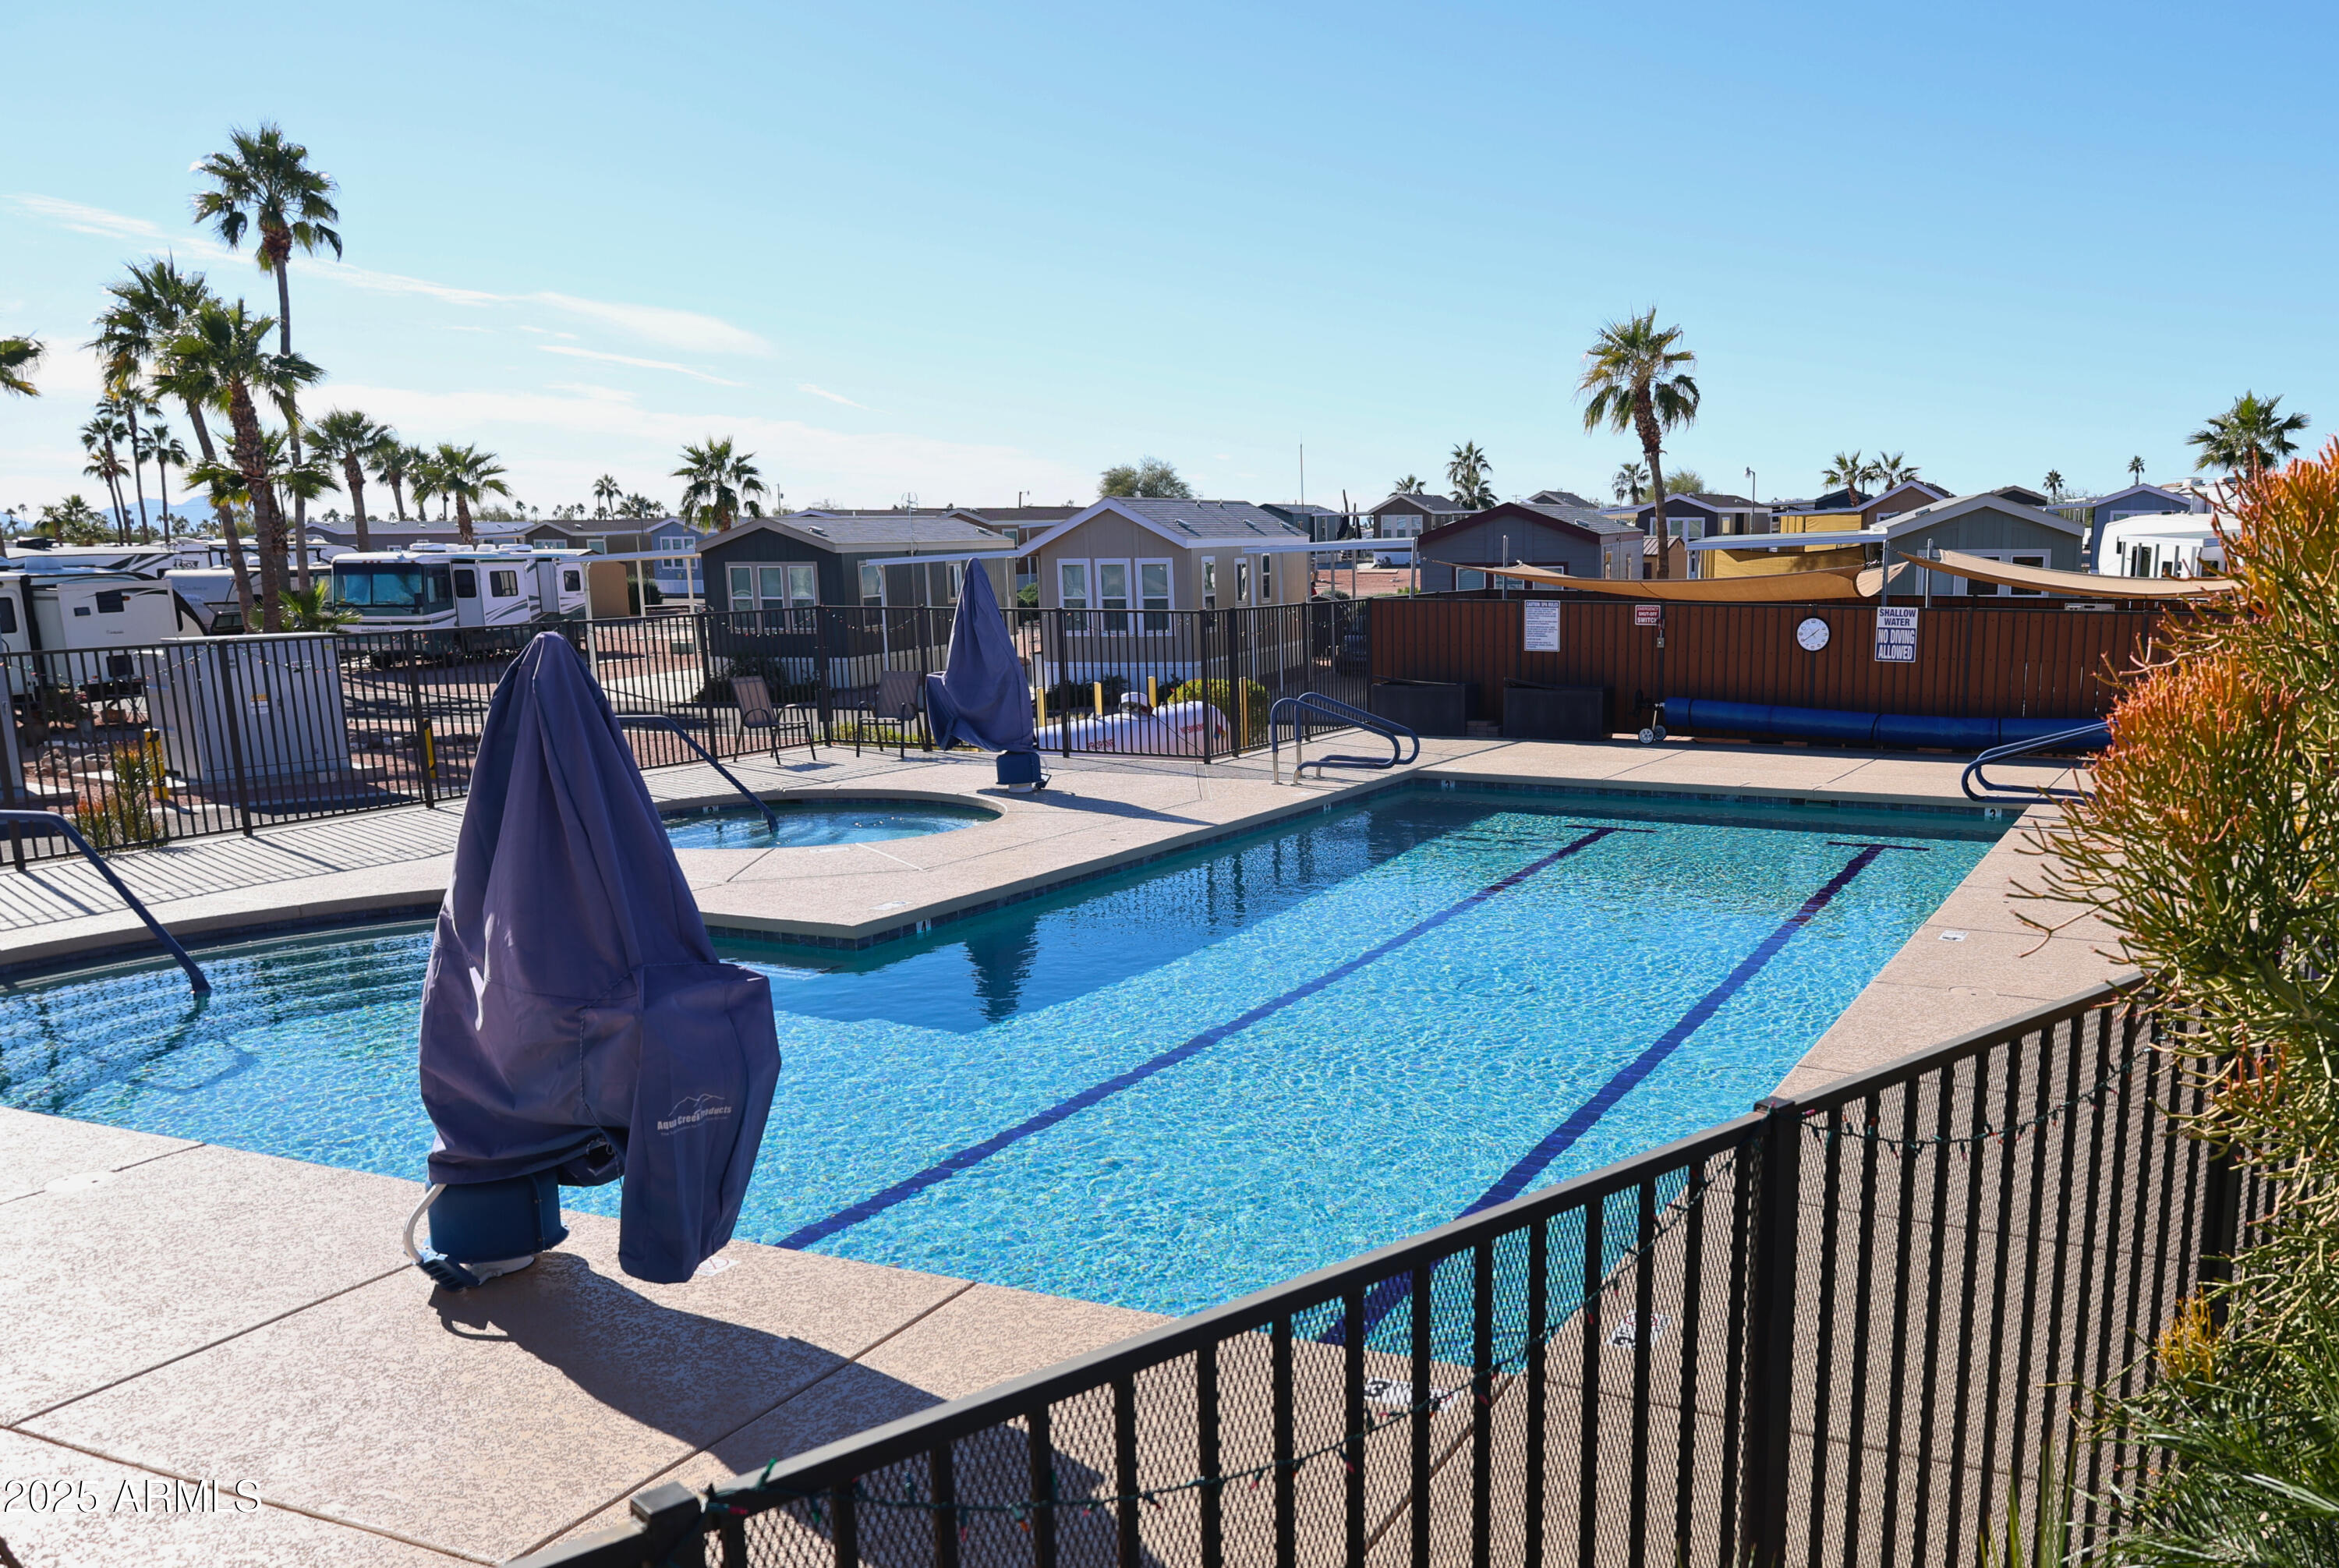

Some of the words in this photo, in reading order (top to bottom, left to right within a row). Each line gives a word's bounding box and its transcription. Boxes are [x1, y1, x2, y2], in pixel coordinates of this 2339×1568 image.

[1879, 608, 1916, 618] SHALLOW
[1884, 618, 1910, 626] WATER
[1877, 628, 1889, 644] NO
[1890, 629, 1915, 645] DIVING
[1877, 645, 1913, 660] ALLOWED
[1087, 739, 1116, 750] PROPN
